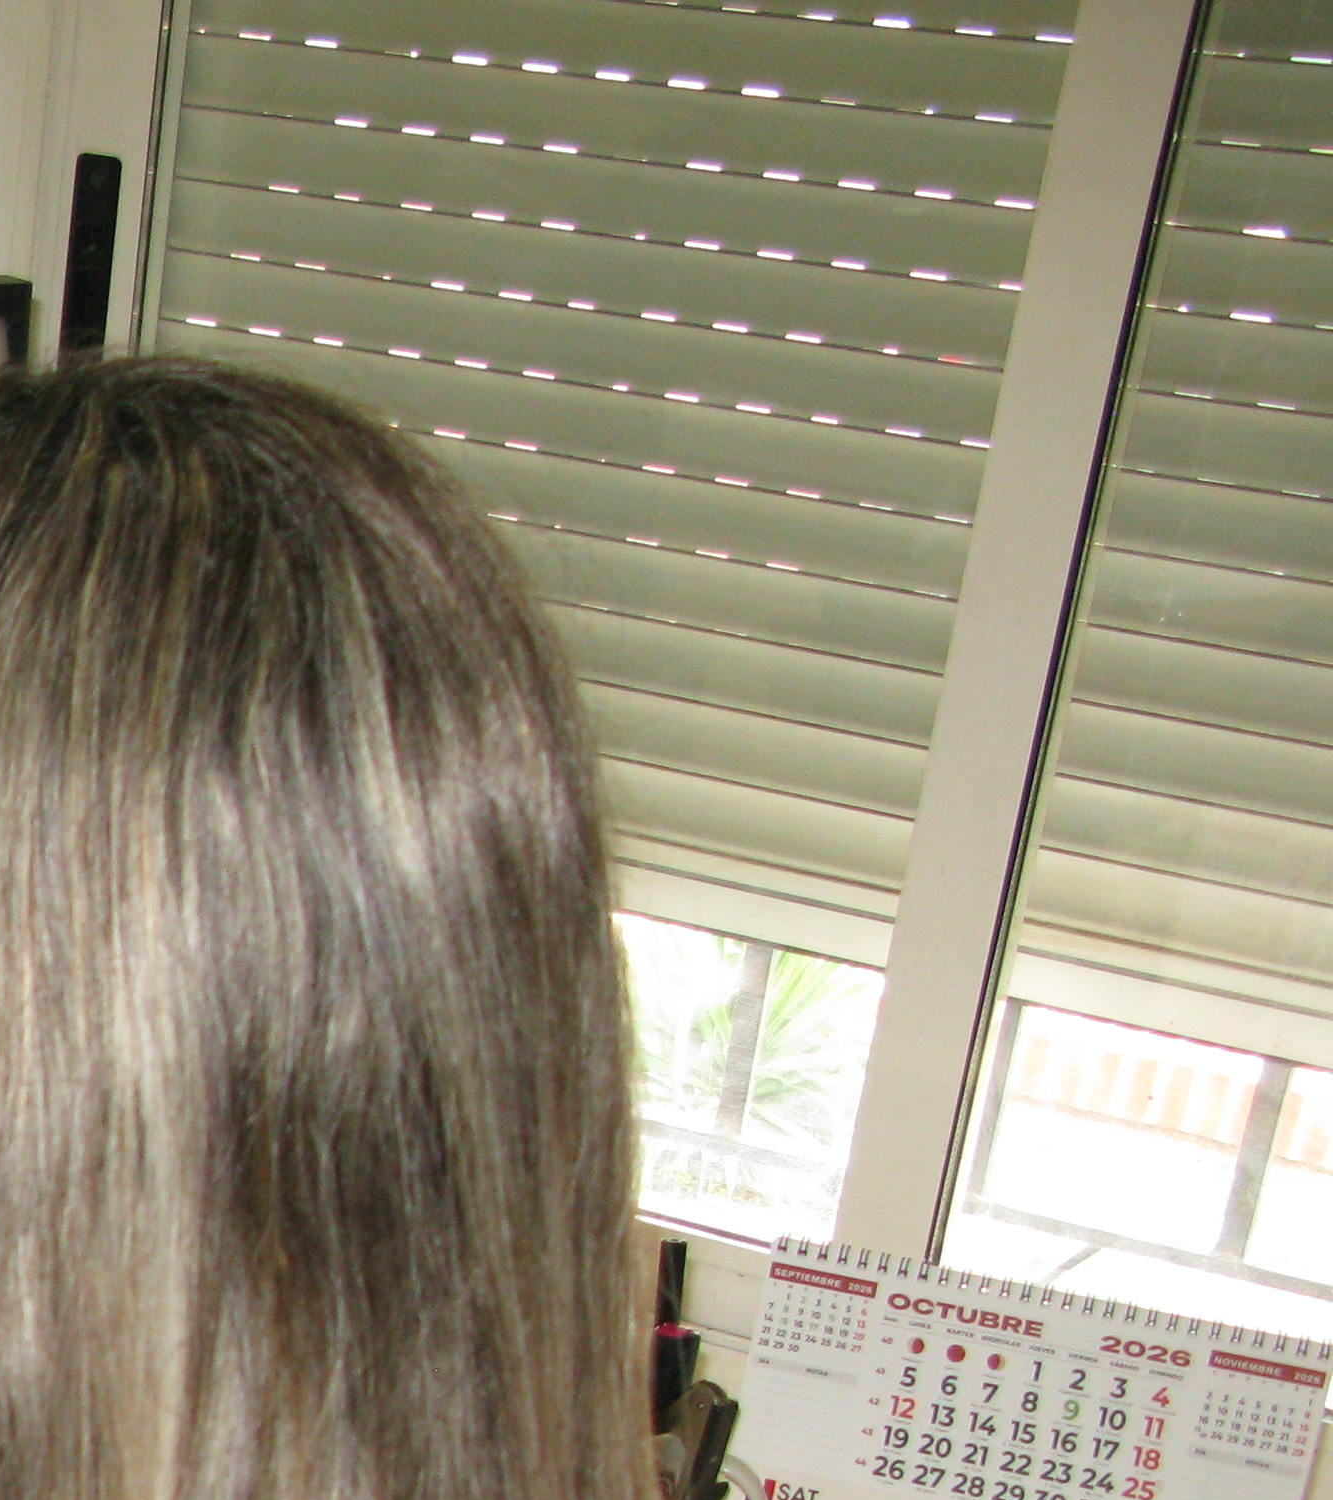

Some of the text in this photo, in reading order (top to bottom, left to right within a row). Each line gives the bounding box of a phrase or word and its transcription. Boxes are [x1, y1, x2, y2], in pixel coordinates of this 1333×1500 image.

[773, 1268, 842, 1288] SEPTIEMBRE
[847, 1281, 873, 1294] 2026
[761, 1326, 862, 1353] 21 22 23 24 25 26 27
[887, 1293, 1044, 1338] OCTUBRE
[1099, 1335, 1192, 1368] 2026
[758, 1337, 800, 1353] 28 29 30
[1213, 1355, 1282, 1377] NOVIEMBRE
[1032, 1361, 1043, 1383] 1
[1068, 1368, 1087, 1391] 2
[1109, 1376, 1129, 1399] 3
[1151, 1386, 1171, 1408] 4
[899, 1366, 917, 1388] 5
[940, 1375, 959, 1396] 6
[981, 1382, 1000, 1404] 7
[1020, 1391, 1039, 1413] 8
[1062, 1399, 1081, 1421] 9
[1099, 1406, 1127, 1431] 10
[1144, 1416, 1166, 1440] 11
[1199, 1415, 1209, 1425] 16
[1215, 1418, 1225, 1428] 17
[1231, 1422, 1241, 1432] 18
[1247, 1426, 1257, 1435] 19
[1262, 1429, 1275, 1438] 20
[1279, 1432, 1290, 1441] 21
[1218, 1406, 1229, 1416] 10
[1235, 1410, 1243, 1419] 11
[1250, 1413, 1261, 1422] 12
[1267, 1416, 1276, 1425] 13
[1282, 1419, 1293, 1429] 14
[890, 1395, 916, 1420] 12
[930, 1403, 956, 1427] 13
[969, 1411, 997, 1437] 14
[1010, 1420, 1037, 1444] 15
[1051, 1428, 1079, 1453] 16
[1092, 1437, 1121, 1461] 17
[1132, 1445, 1161, 1471] 18
[1210, 1431, 1223, 1441] 24
[1242, 1438, 1255, 1448] 26
[1258, 1441, 1272, 1450] 27
[1275, 1444, 1288, 1454] 28
[883, 1425, 910, 1449] 19
[917, 1433, 953, 1459] 20
[961, 1442, 990, 1468] 21
[999, 1450, 1032, 1477] 22
[1039, 1458, 1074, 1485] 23
[1078, 1467, 1115, 1494] 24
[871, 1454, 906, 1481] 26
[911, 1464, 947, 1489] 27
[951, 1472, 985, 1498] 28
